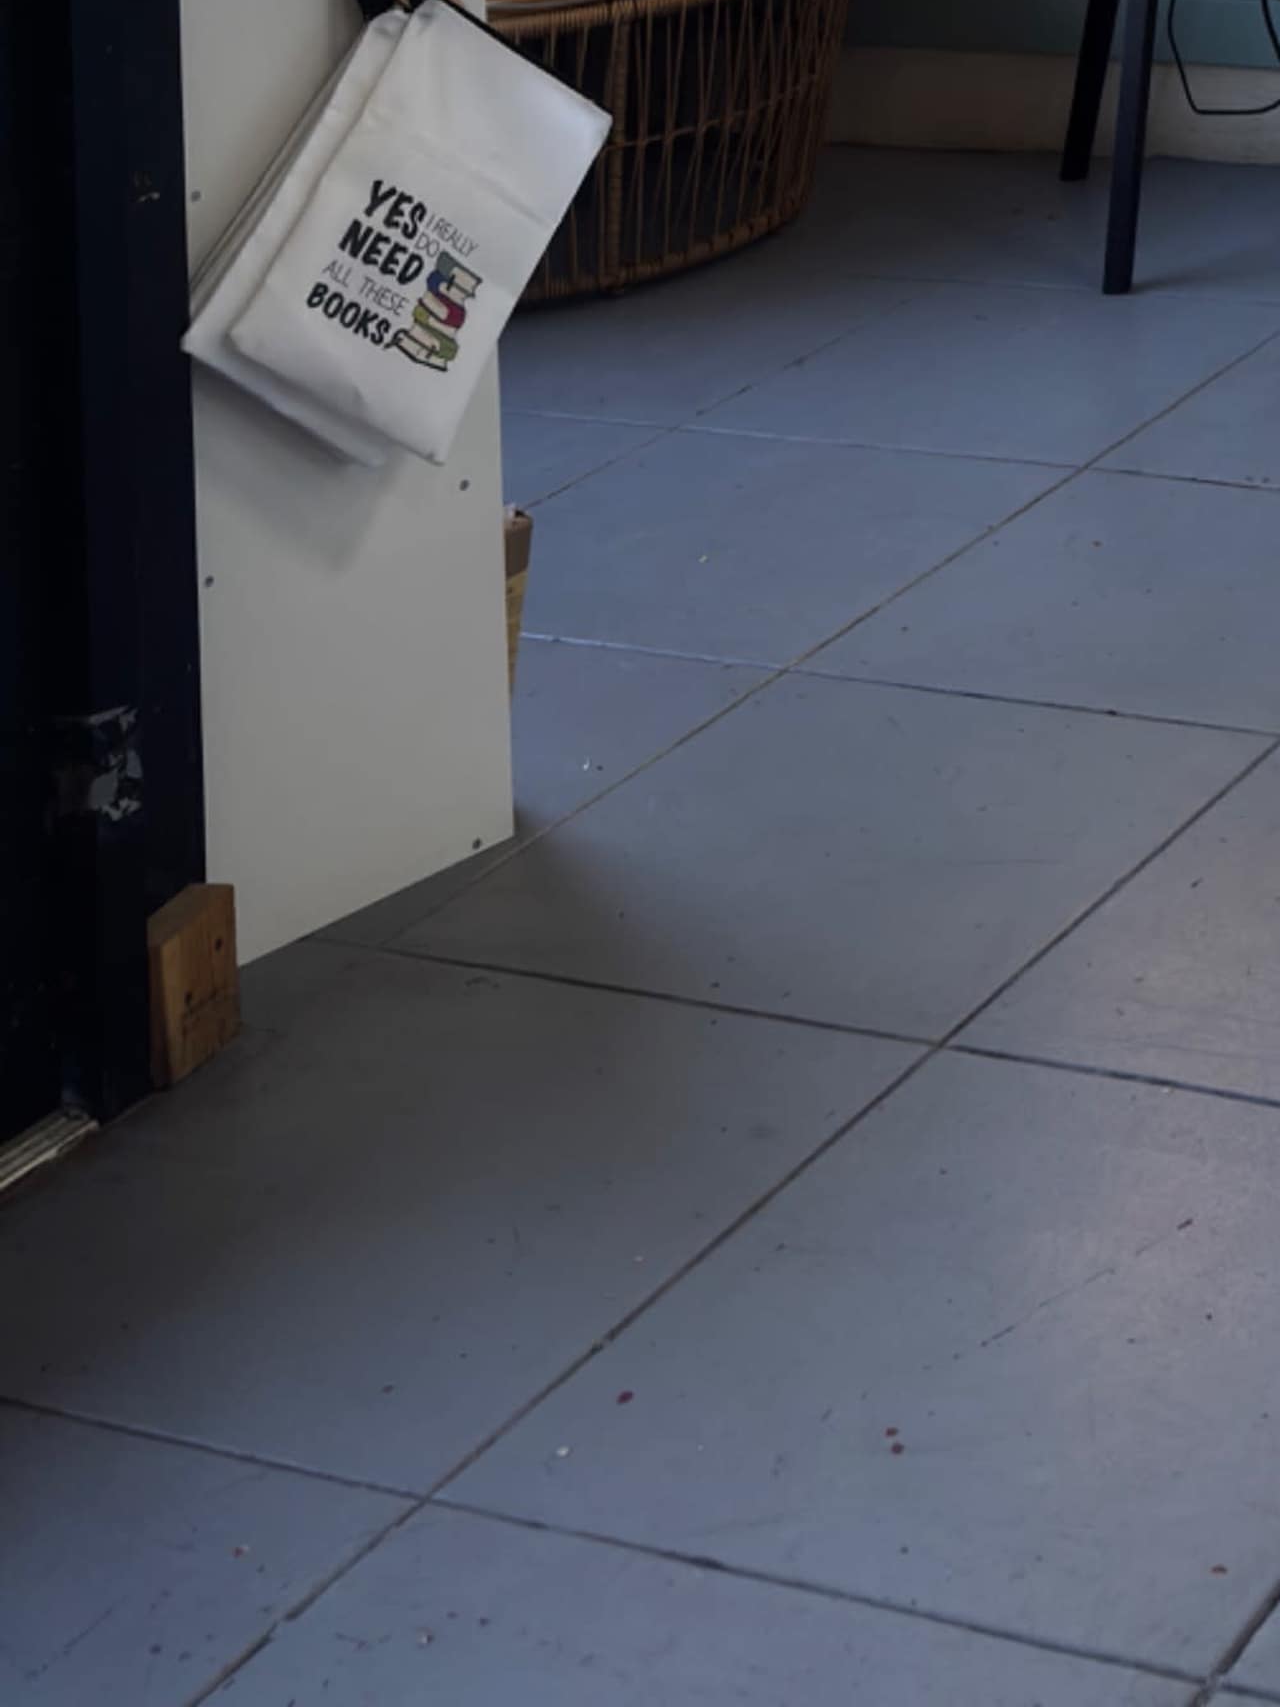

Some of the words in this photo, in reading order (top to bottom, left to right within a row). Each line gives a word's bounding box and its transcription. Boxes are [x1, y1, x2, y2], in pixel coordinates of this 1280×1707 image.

[364, 180, 427, 240] YES
[426, 214, 436, 228] I
[432, 217, 480, 258] REALLY
[338, 218, 425, 286] NEED
[414, 233, 441, 259] DO
[306, 282, 391, 346] BOOKS
[322, 259, 353, 288] ALL
[358, 276, 410, 316] THESE
